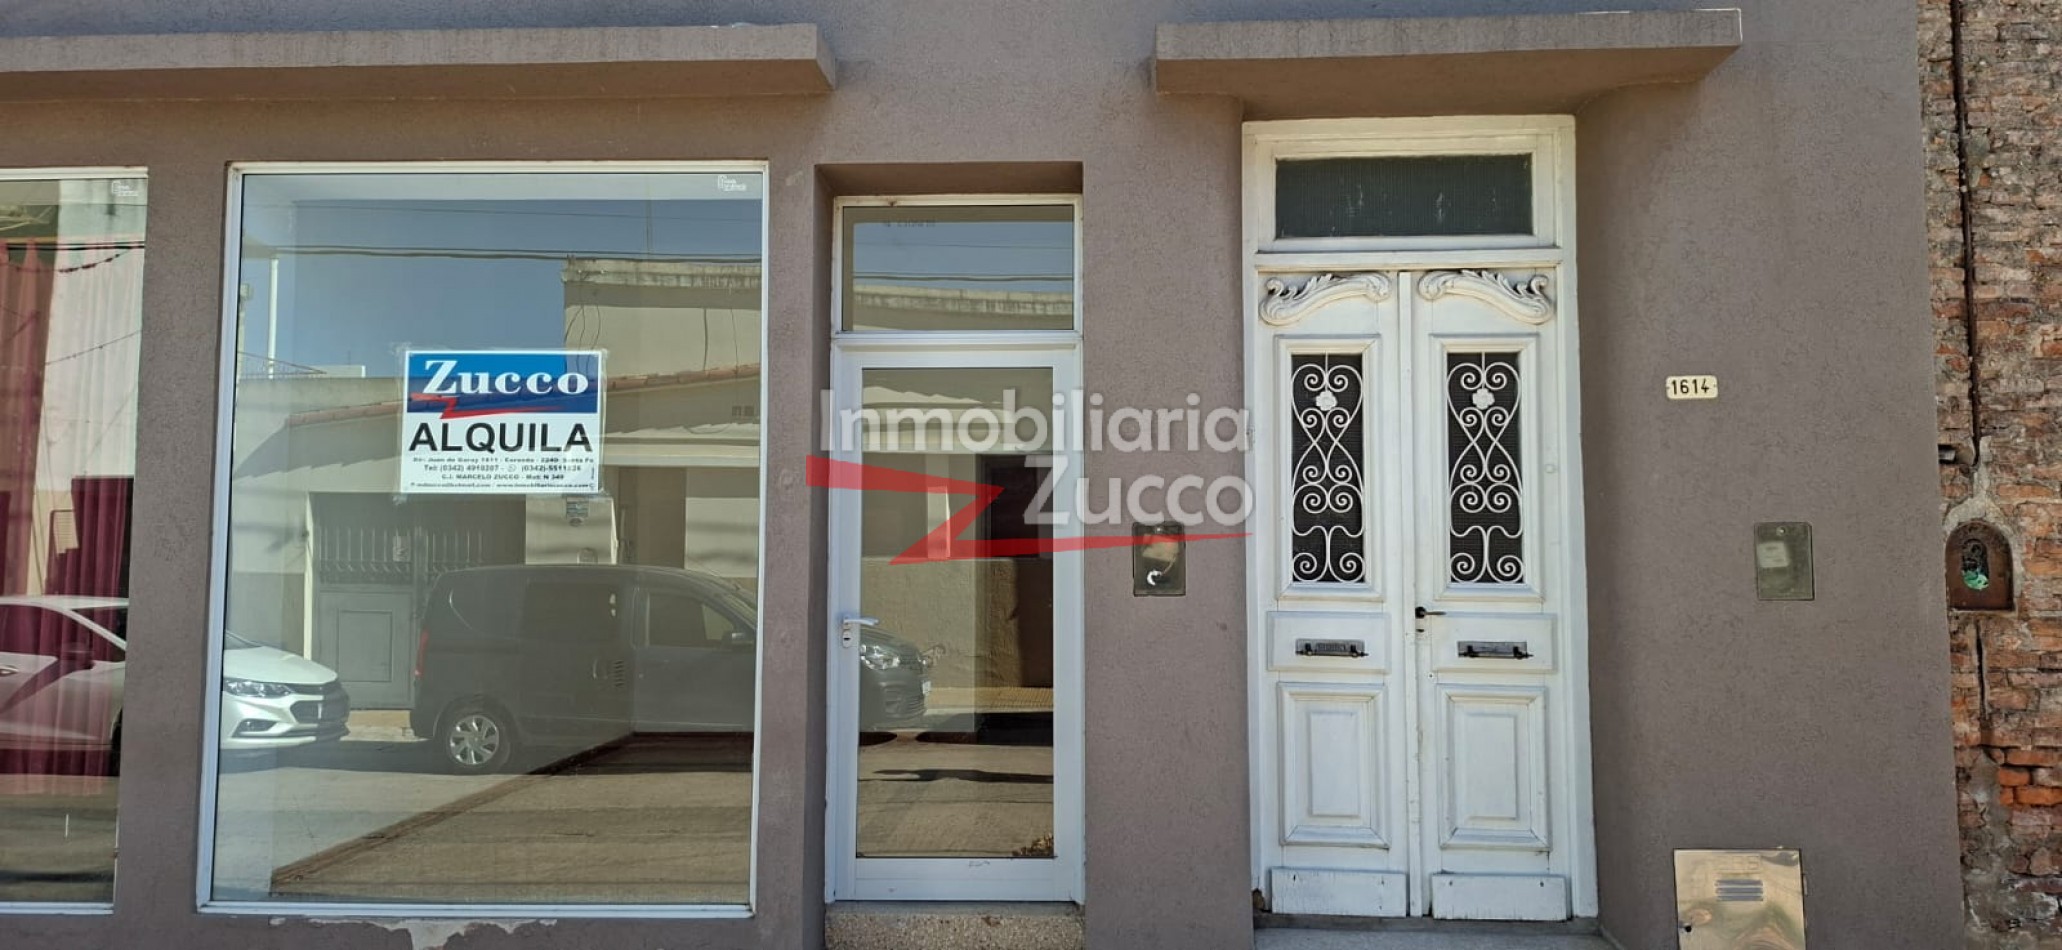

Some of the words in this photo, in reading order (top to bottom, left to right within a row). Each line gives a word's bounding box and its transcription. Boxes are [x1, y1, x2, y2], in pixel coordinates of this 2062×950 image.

[422, 360, 588, 394] Zucco
[1671, 378, 1710, 395] 1614
[409, 423, 592, 454] ALQUILA
